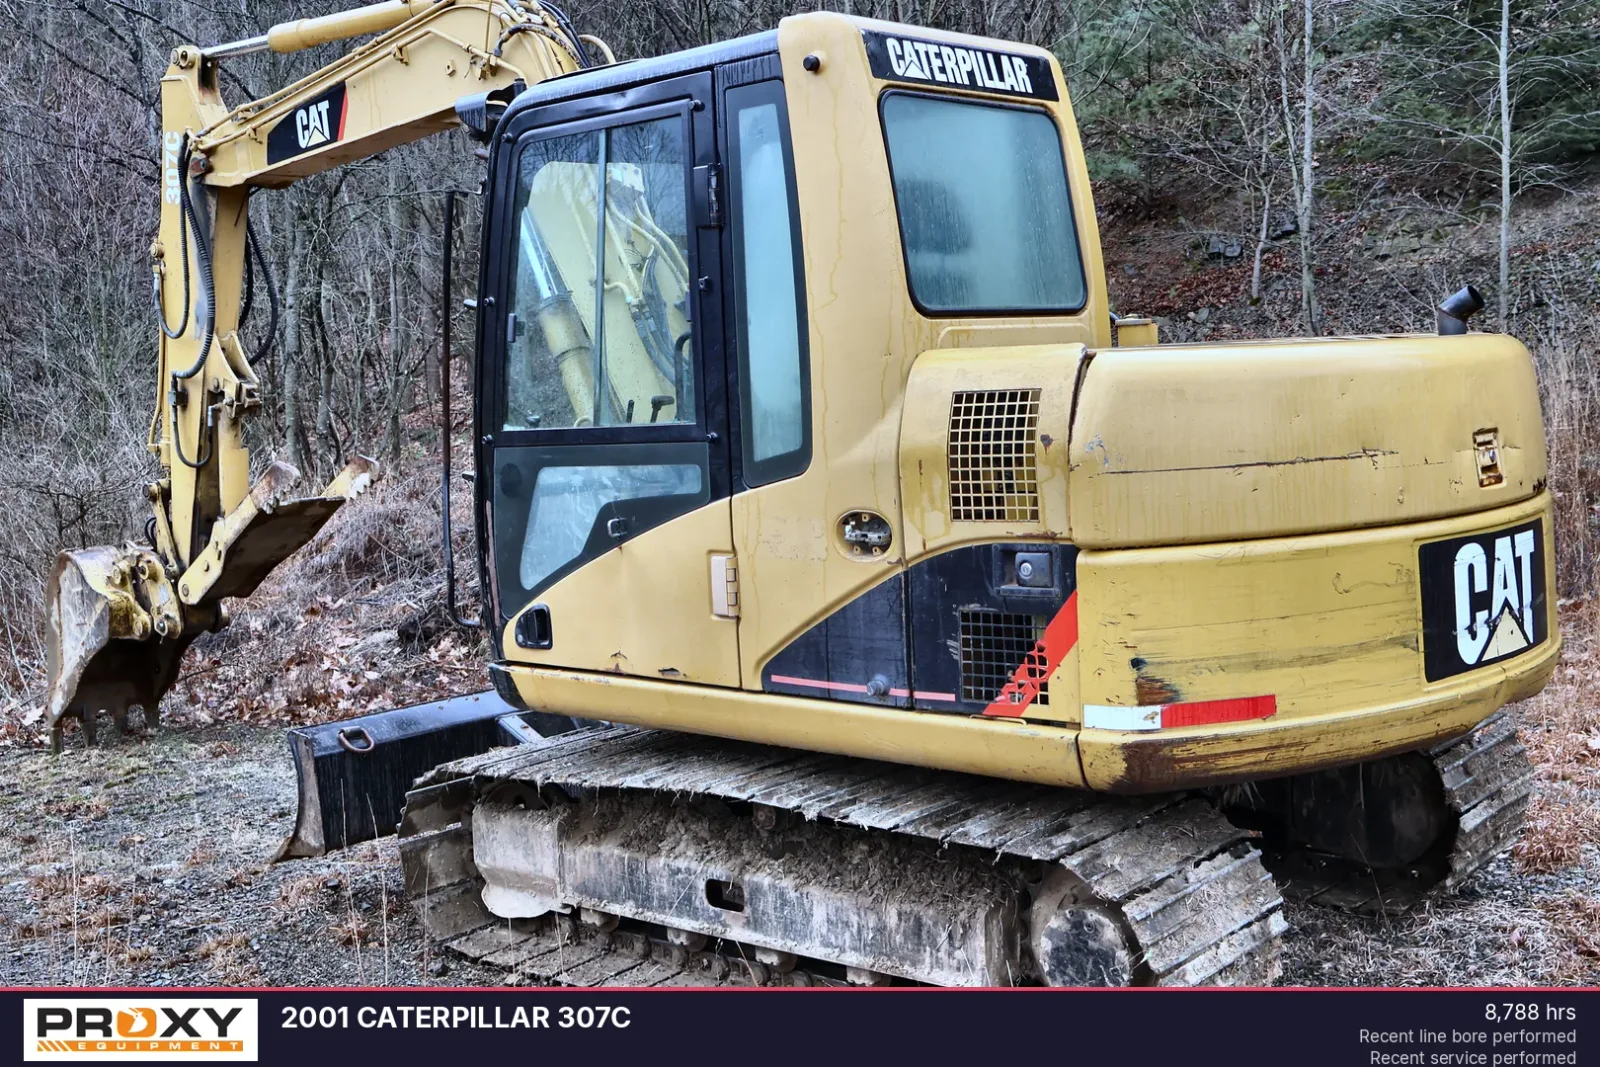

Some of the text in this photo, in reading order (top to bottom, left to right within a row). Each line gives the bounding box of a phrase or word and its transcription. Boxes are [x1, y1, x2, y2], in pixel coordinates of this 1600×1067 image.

[886, 37, 1033, 94] CATERPILLAR
[295, 99, 331, 149] CAT
[164, 131, 181, 205] 307C
[1453, 529, 1535, 666] CAT
